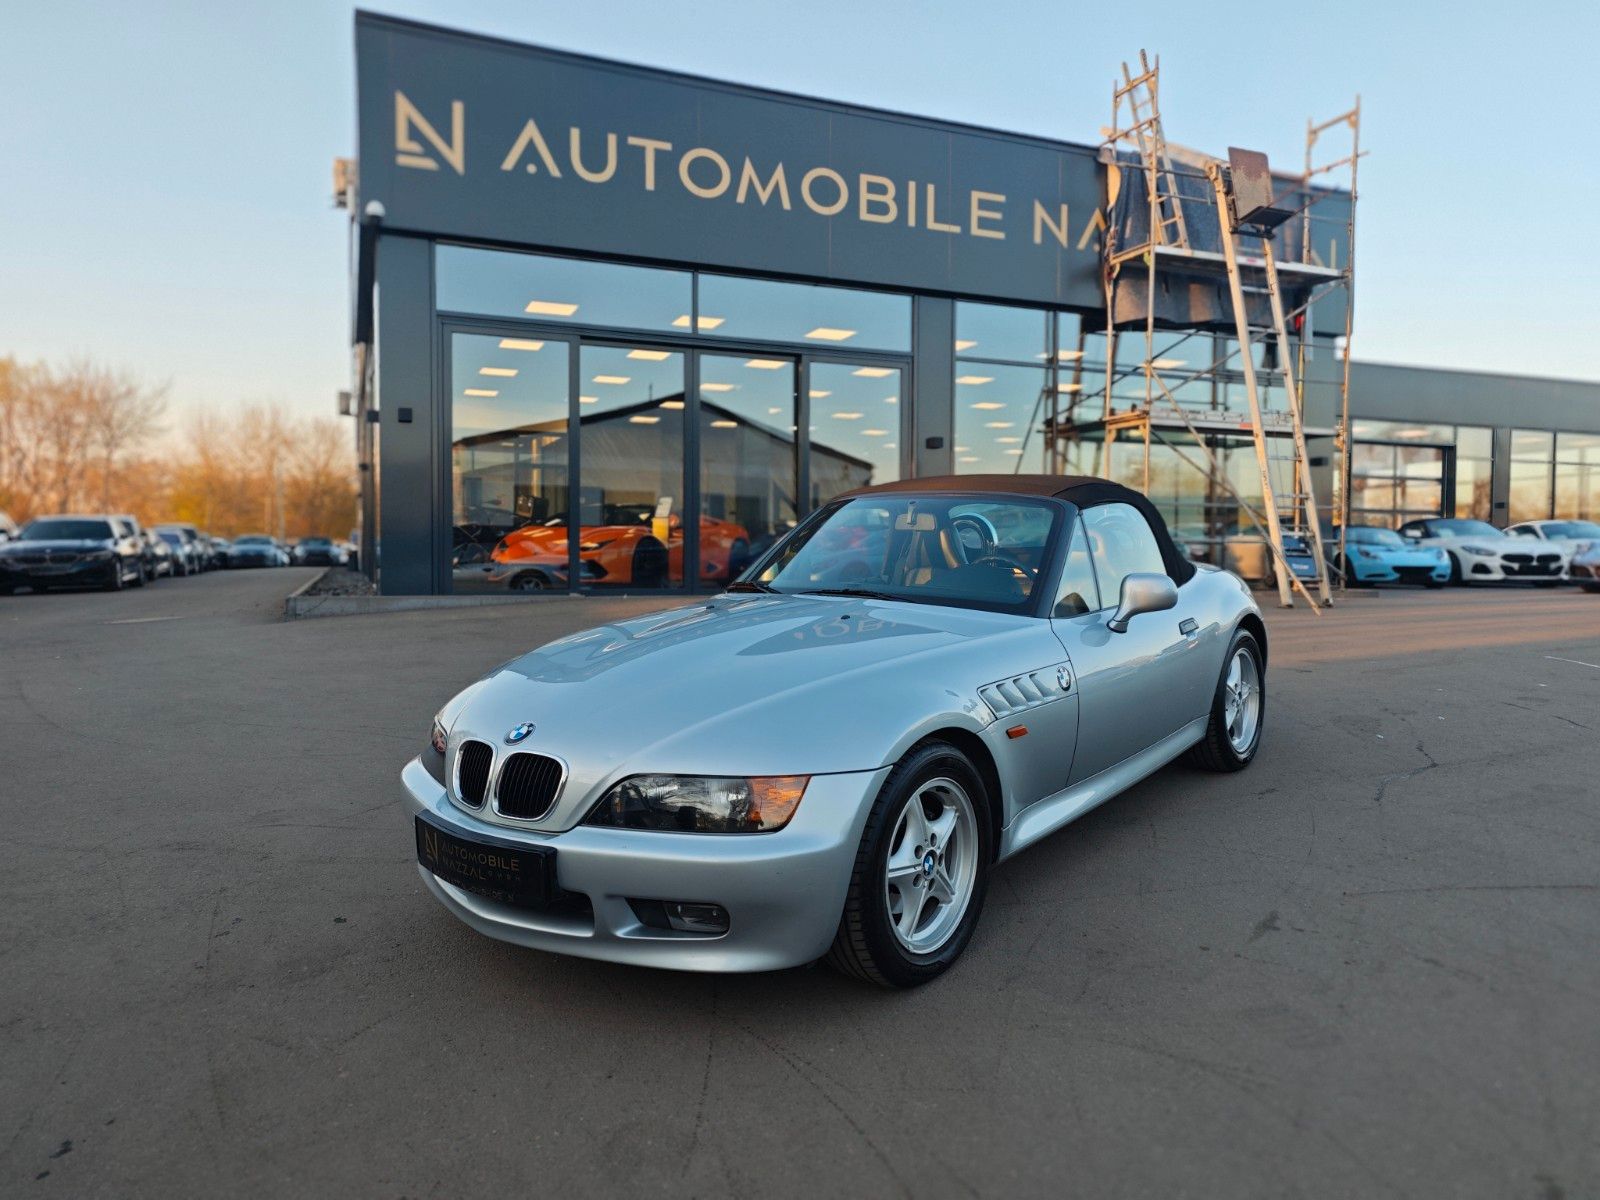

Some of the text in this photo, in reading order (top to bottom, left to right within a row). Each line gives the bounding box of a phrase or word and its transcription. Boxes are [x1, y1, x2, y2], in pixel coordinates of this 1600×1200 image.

[501, 119, 1006, 241] AUTOMOBILE
[442, 841, 520, 872] AUTOMOBILE
[443, 856, 487, 880] NAZZAL
